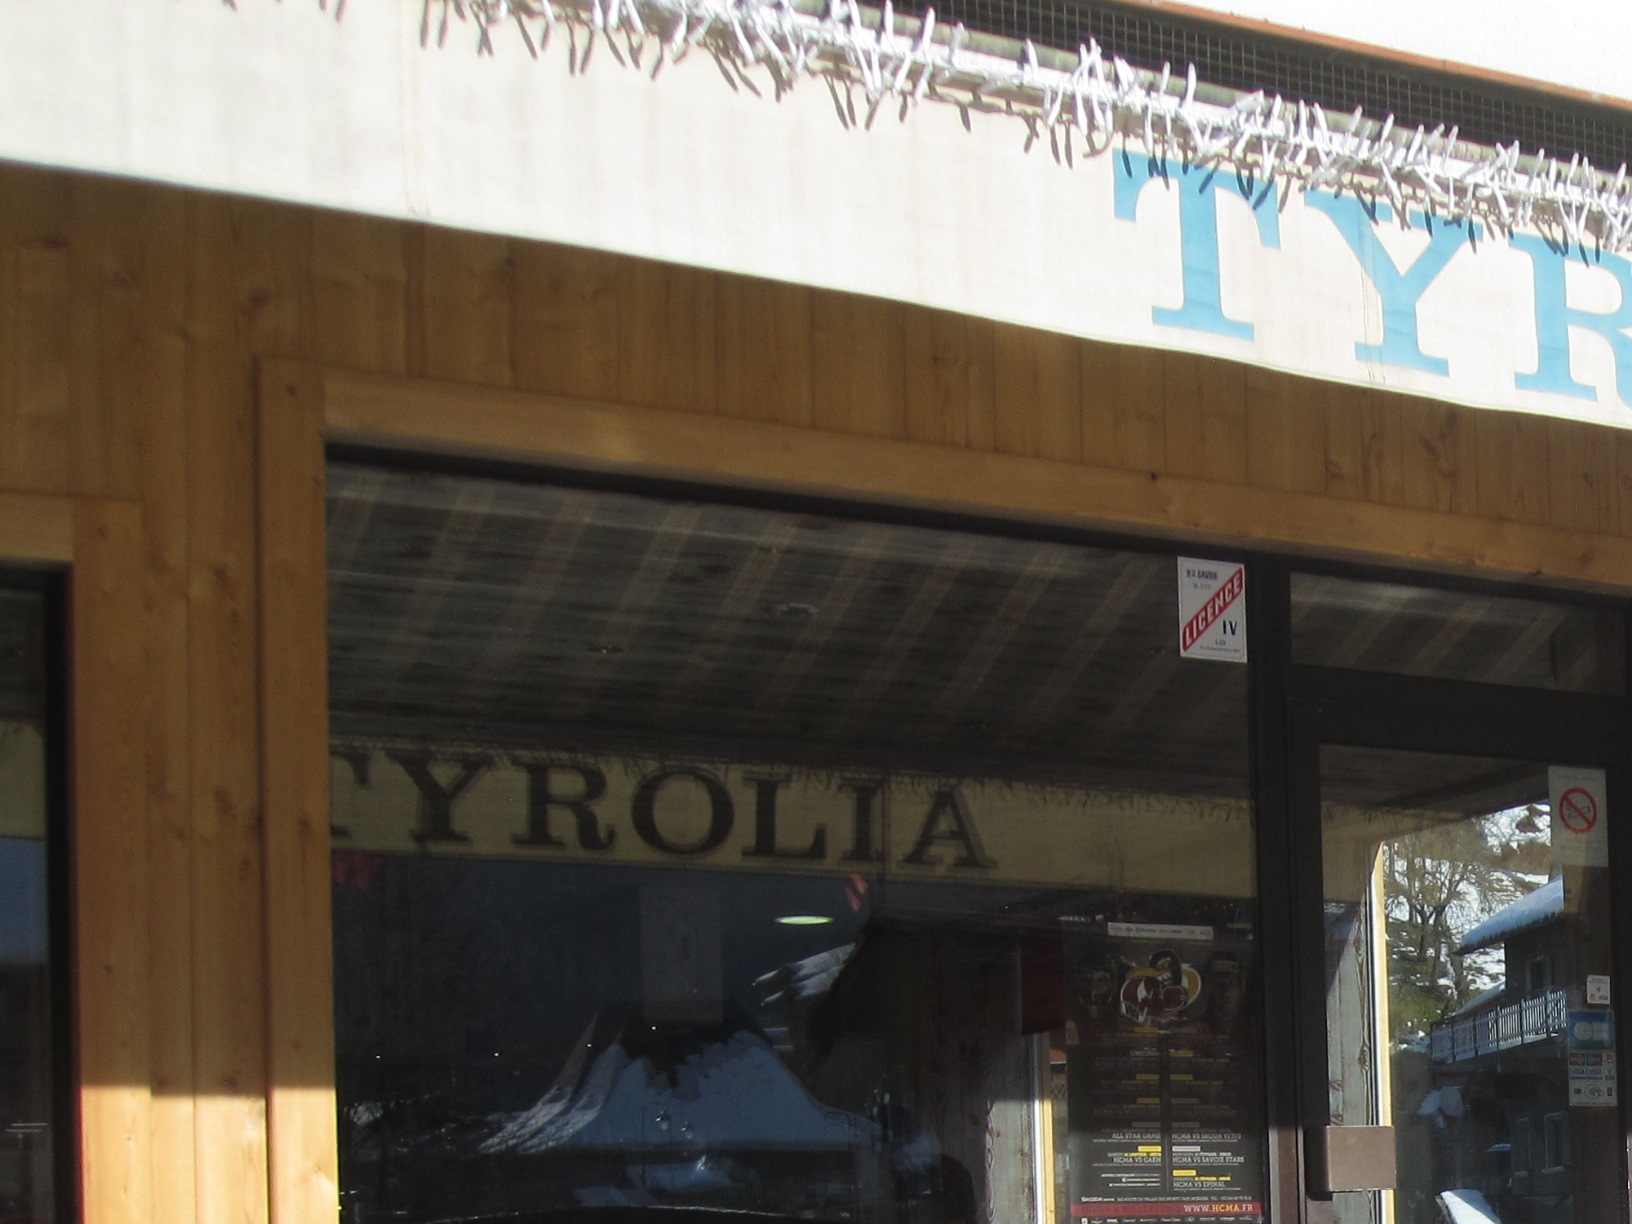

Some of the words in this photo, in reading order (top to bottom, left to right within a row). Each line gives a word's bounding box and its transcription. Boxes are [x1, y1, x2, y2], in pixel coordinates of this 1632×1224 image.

[1184, 574, 1242, 648] LICENCE
[1223, 620, 1237, 636] IV
[1183, 1204, 1254, 1213] WWW.HCMA.FR
